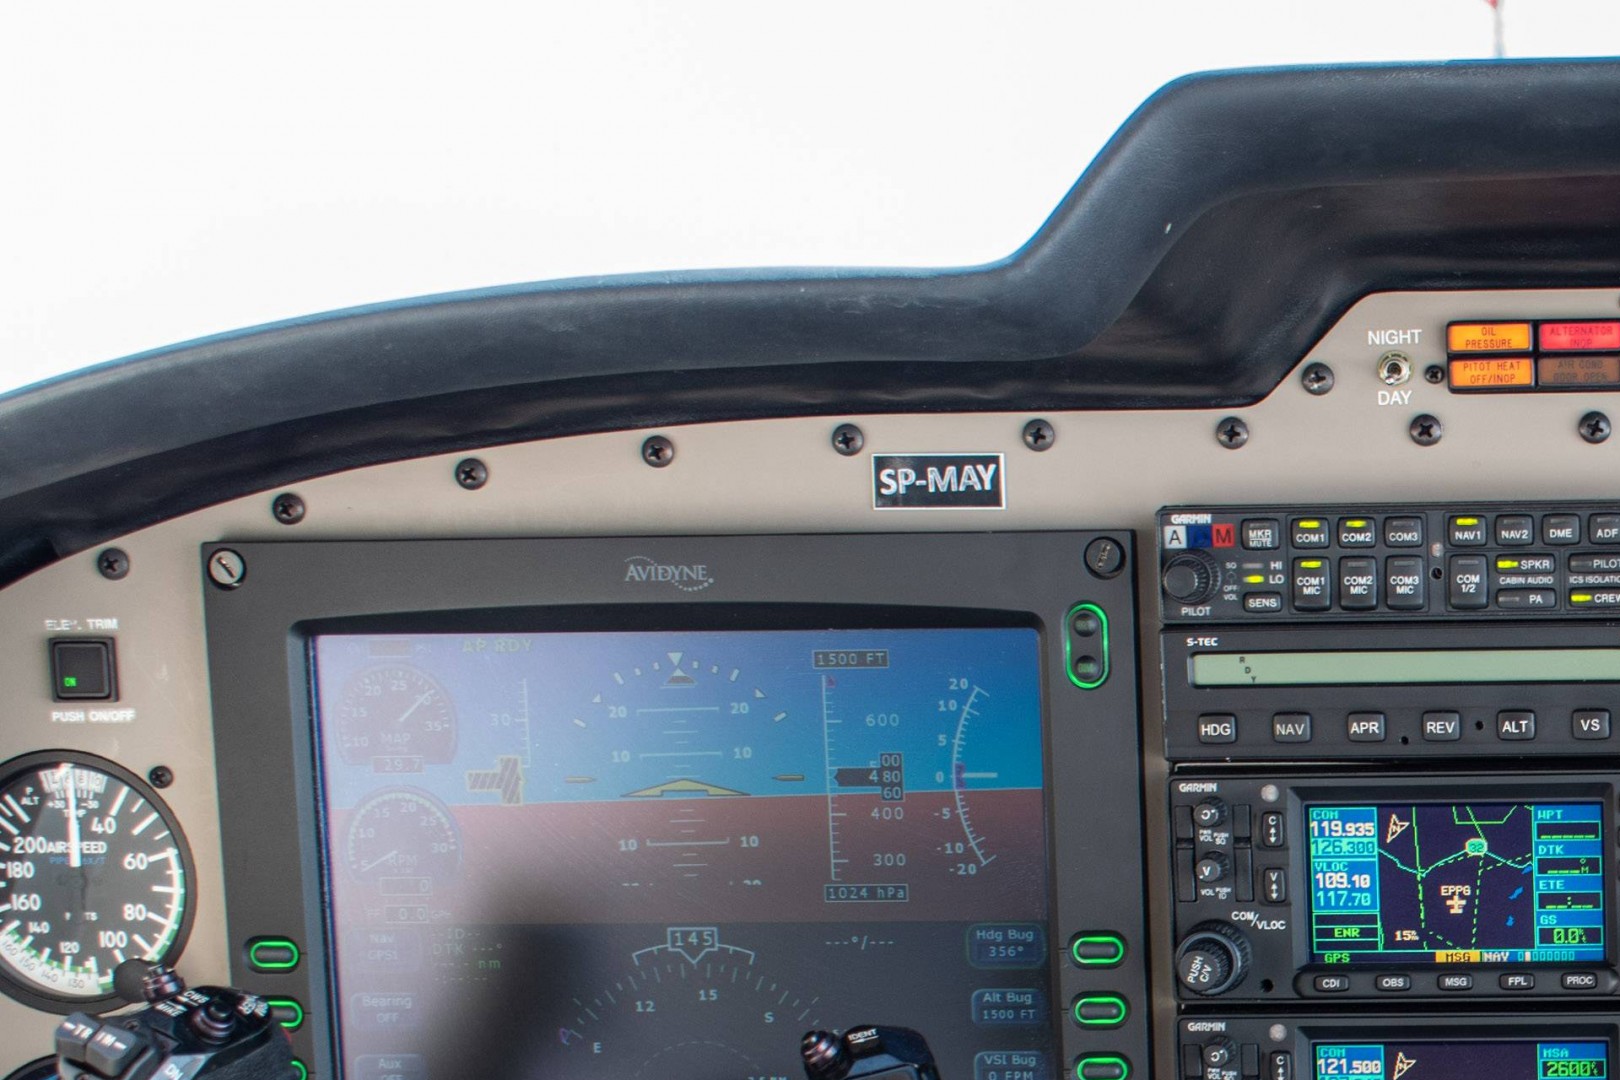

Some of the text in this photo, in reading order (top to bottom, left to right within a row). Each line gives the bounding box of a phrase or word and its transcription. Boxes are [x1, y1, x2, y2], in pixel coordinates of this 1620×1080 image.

[1481, 327, 1497, 336] OIL
[1368, 330, 1422, 345] NIGHT
[1465, 339, 1513, 349] PRESSURE
[1463, 360, 1521, 371] PITOT HEAT
[1378, 390, 1412, 405] DAY
[880, 464, 998, 495] SP-MAY
[1550, 529, 1572, 538] DME
[1596, 529, 1618, 538] ADF
[625, 564, 708, 581] AVIDYNE
[1181, 607, 1211, 616] PILOT
[818, 653, 884, 666] 1500 FT
[866, 714, 899, 727] 600
[1580, 720, 1600, 730] VS
[1201, 724, 1231, 736] HDG
[1277, 724, 1305, 735] NAV
[1350, 723, 1379, 734] APR
[1427, 722, 1455, 733] REV
[1502, 721, 1528, 732] ALT
[1179, 783, 1217, 792] GARMIN
[871, 808, 904, 820] 400
[873, 854, 906, 866] 300
[1441, 886, 1471, 895] EPPG
[1323, 979, 1340, 987] CDI
[1382, 978, 1404, 987] OBS
[1445, 978, 1467, 986] MSG
[1508, 977, 1527, 986] FPL
[1567, 976, 1593, 984] PROC
